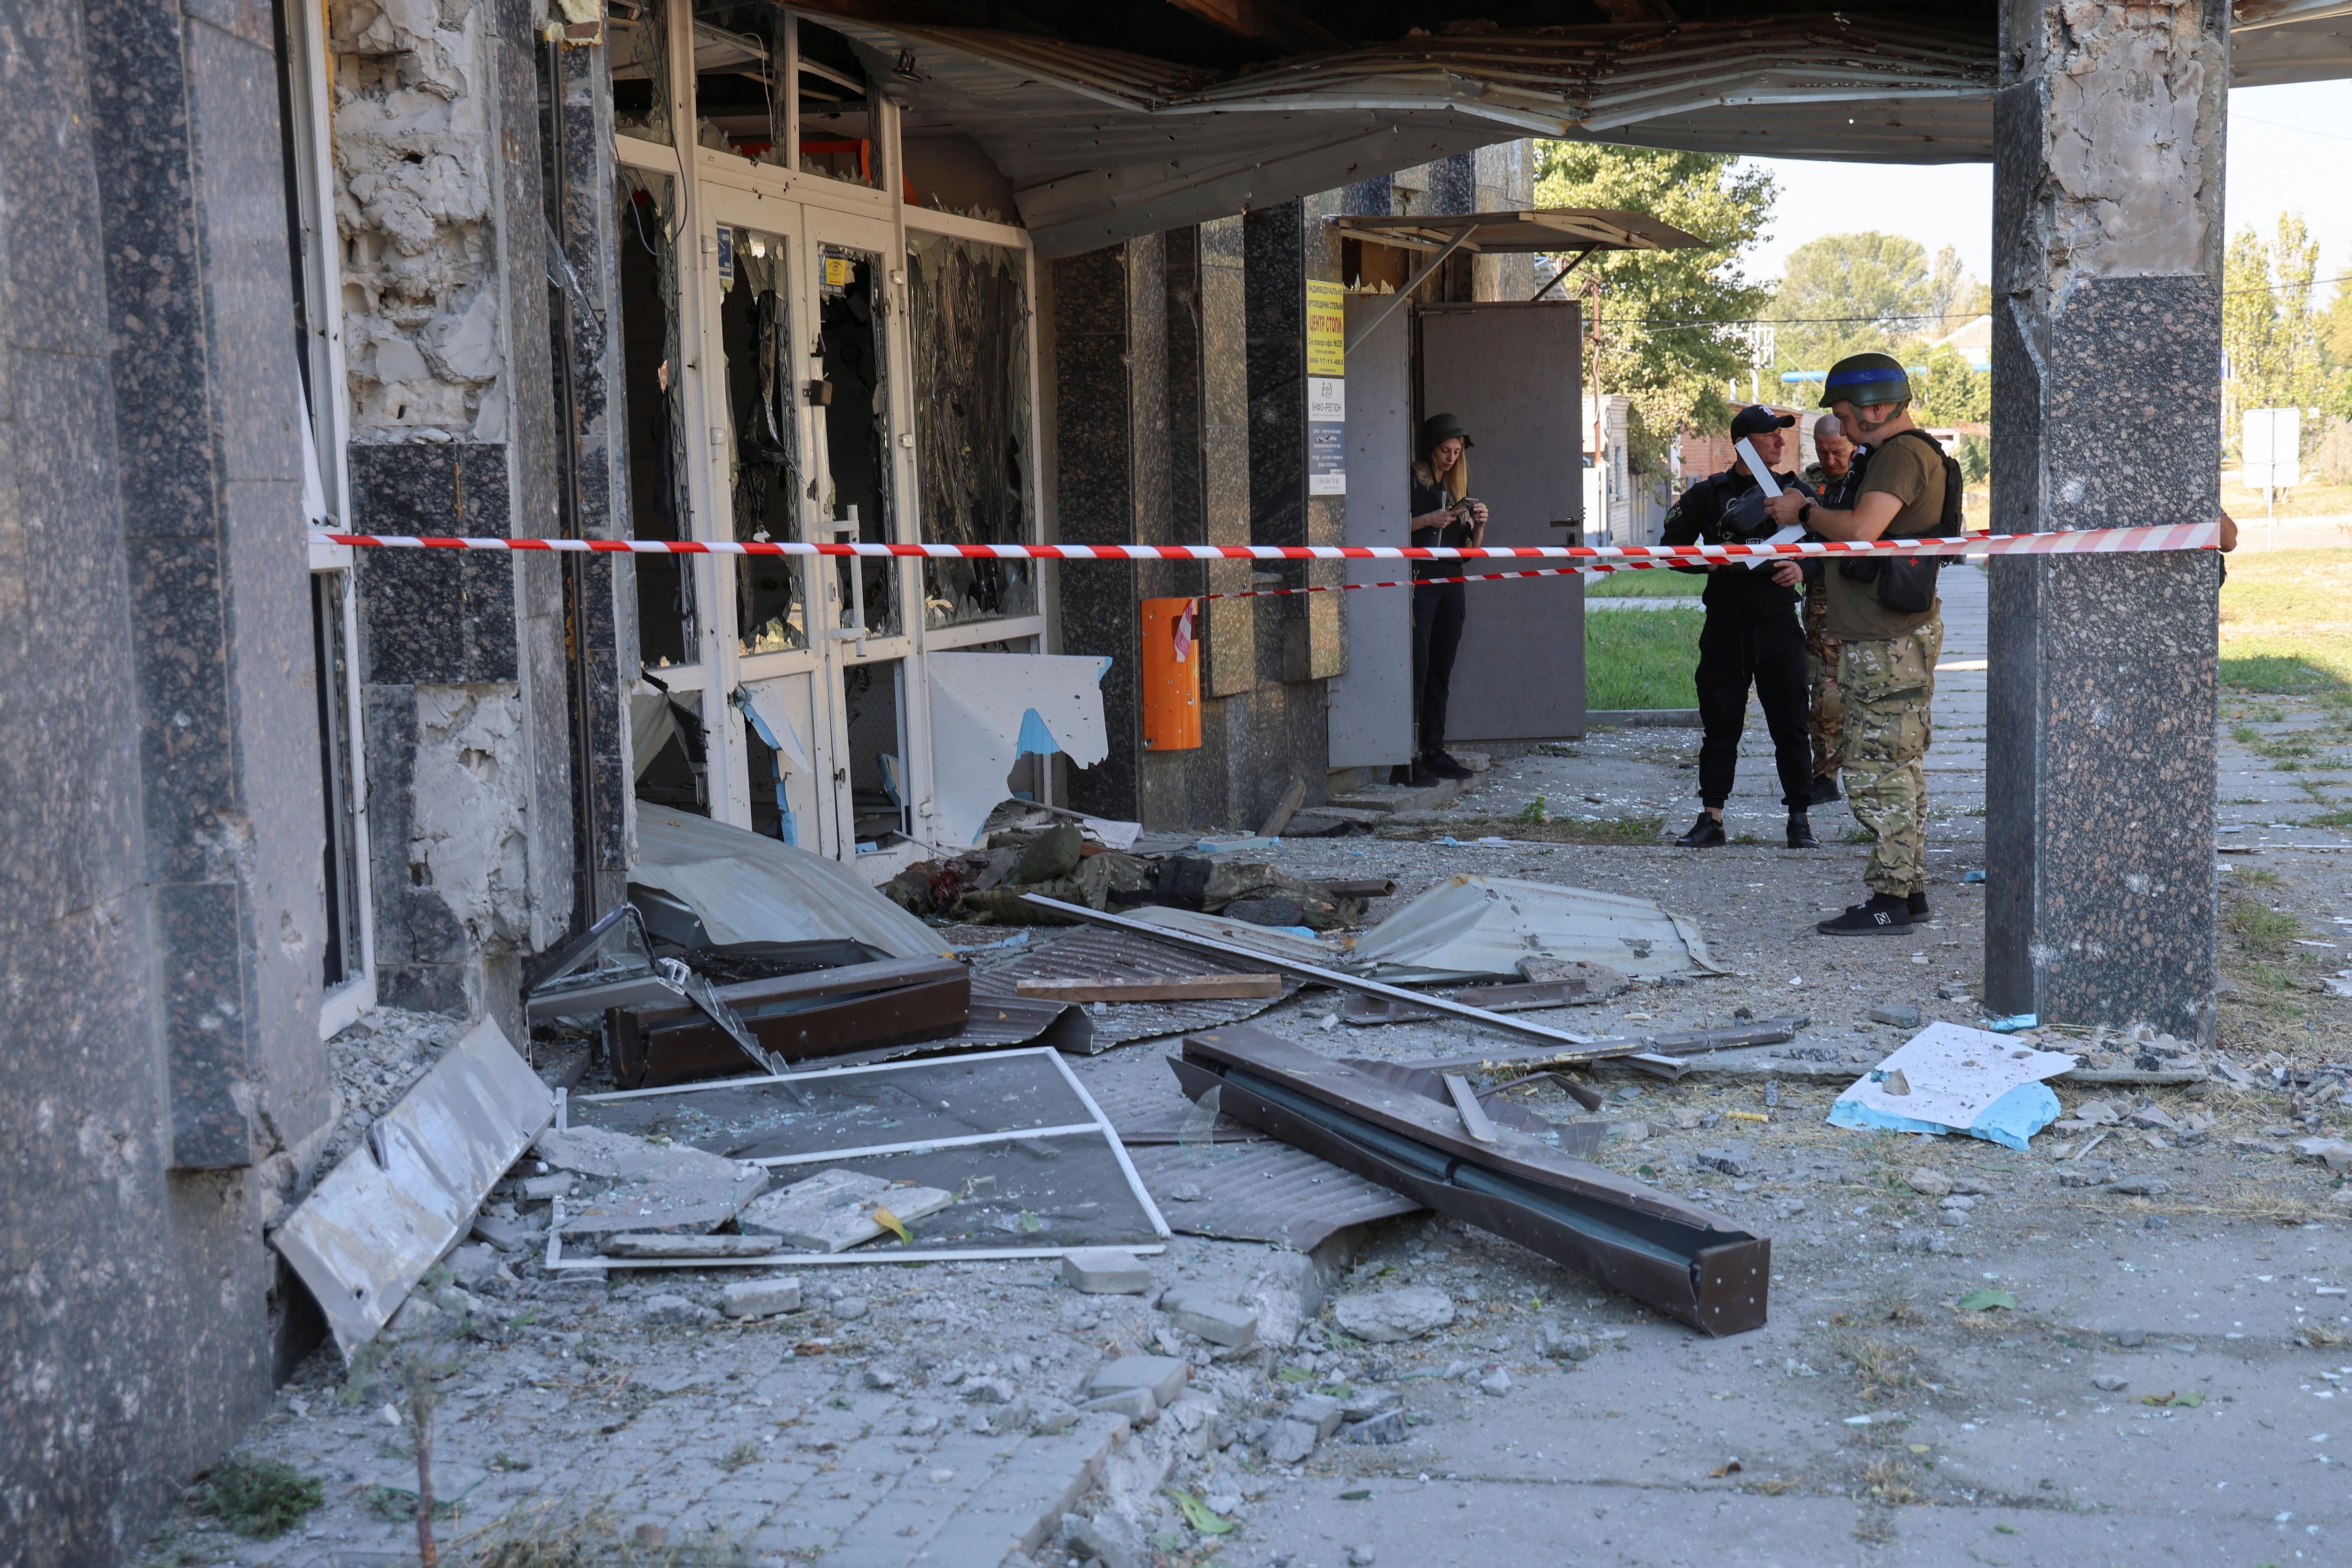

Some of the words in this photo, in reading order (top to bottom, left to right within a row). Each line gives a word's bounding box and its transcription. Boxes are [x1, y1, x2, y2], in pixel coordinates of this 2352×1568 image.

[1308, 285, 1343, 295] ІНДИВІДУАЛЬНІ
[1308, 299, 1329, 310] ОРТОПЕДИЧНІ
[1330, 302, 1344, 310] СТЕЛЬКИ
[1314, 339, 1325, 348] поверх
[1312, 402, 1342, 412] ІНФО-РЕГІОН
[1874, 912, 1891, 925] N
